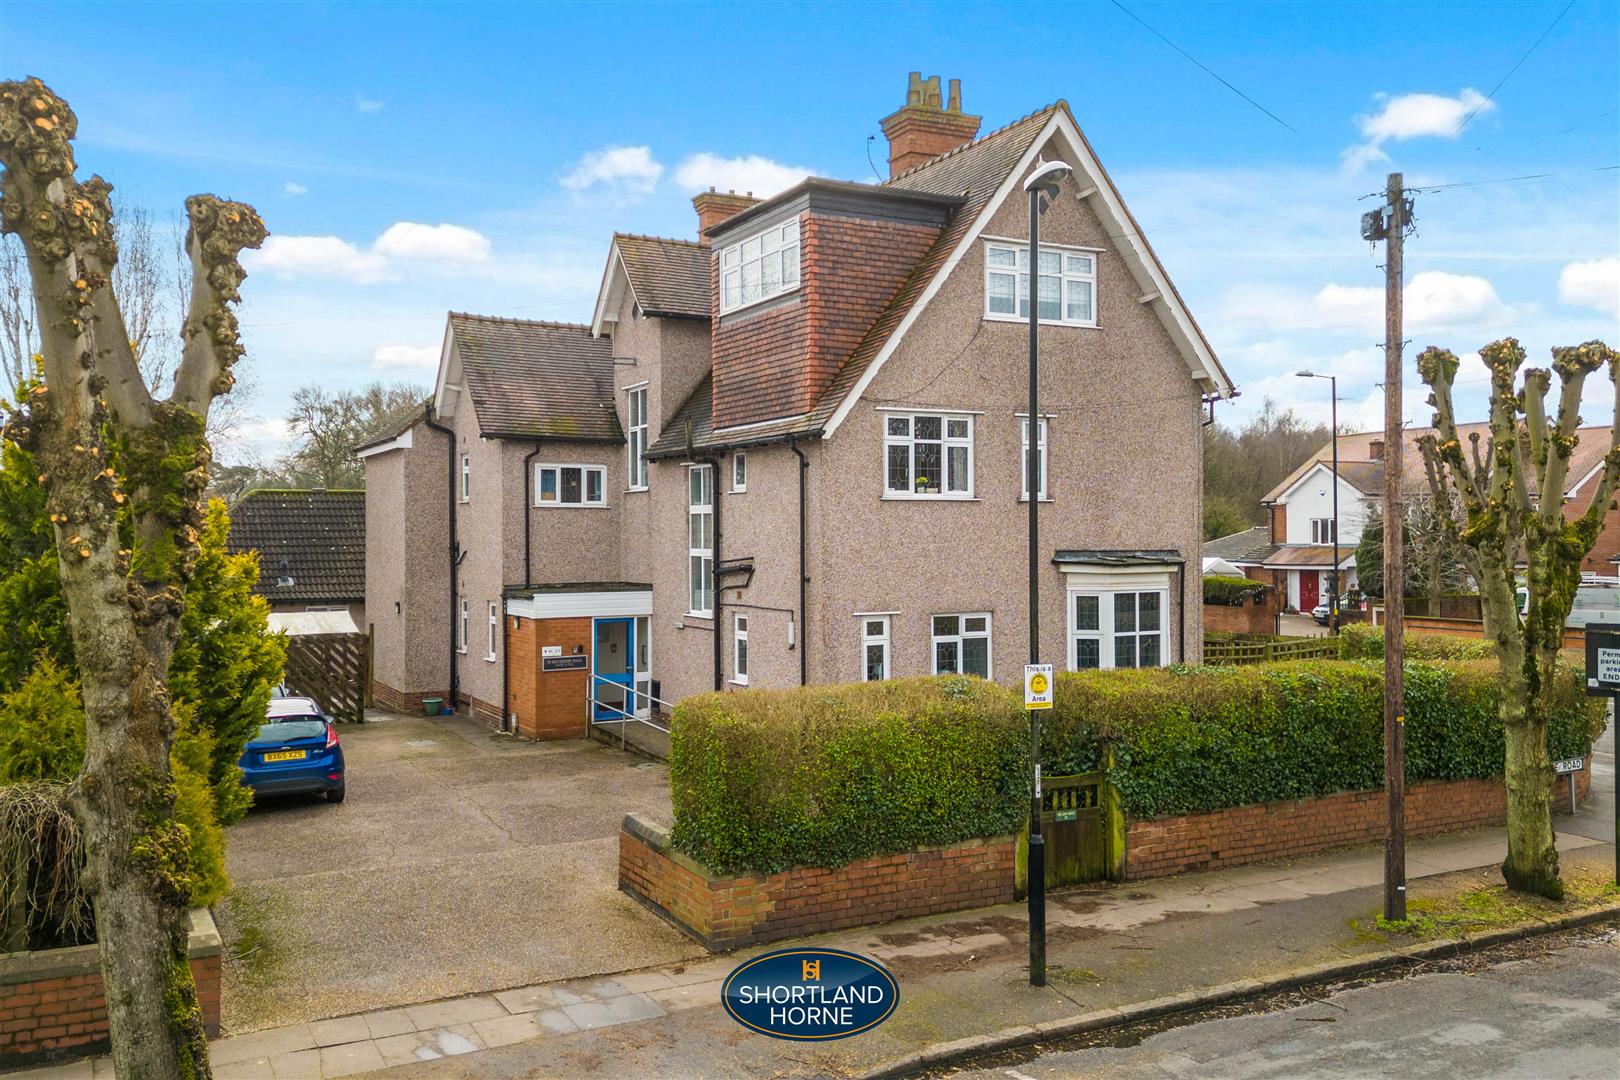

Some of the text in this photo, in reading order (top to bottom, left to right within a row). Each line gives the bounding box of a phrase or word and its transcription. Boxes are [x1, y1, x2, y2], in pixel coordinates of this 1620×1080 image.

[1026, 665, 1040, 673] This
[267, 752, 287, 761] BX65
[1563, 760, 1581, 771] ROAD
